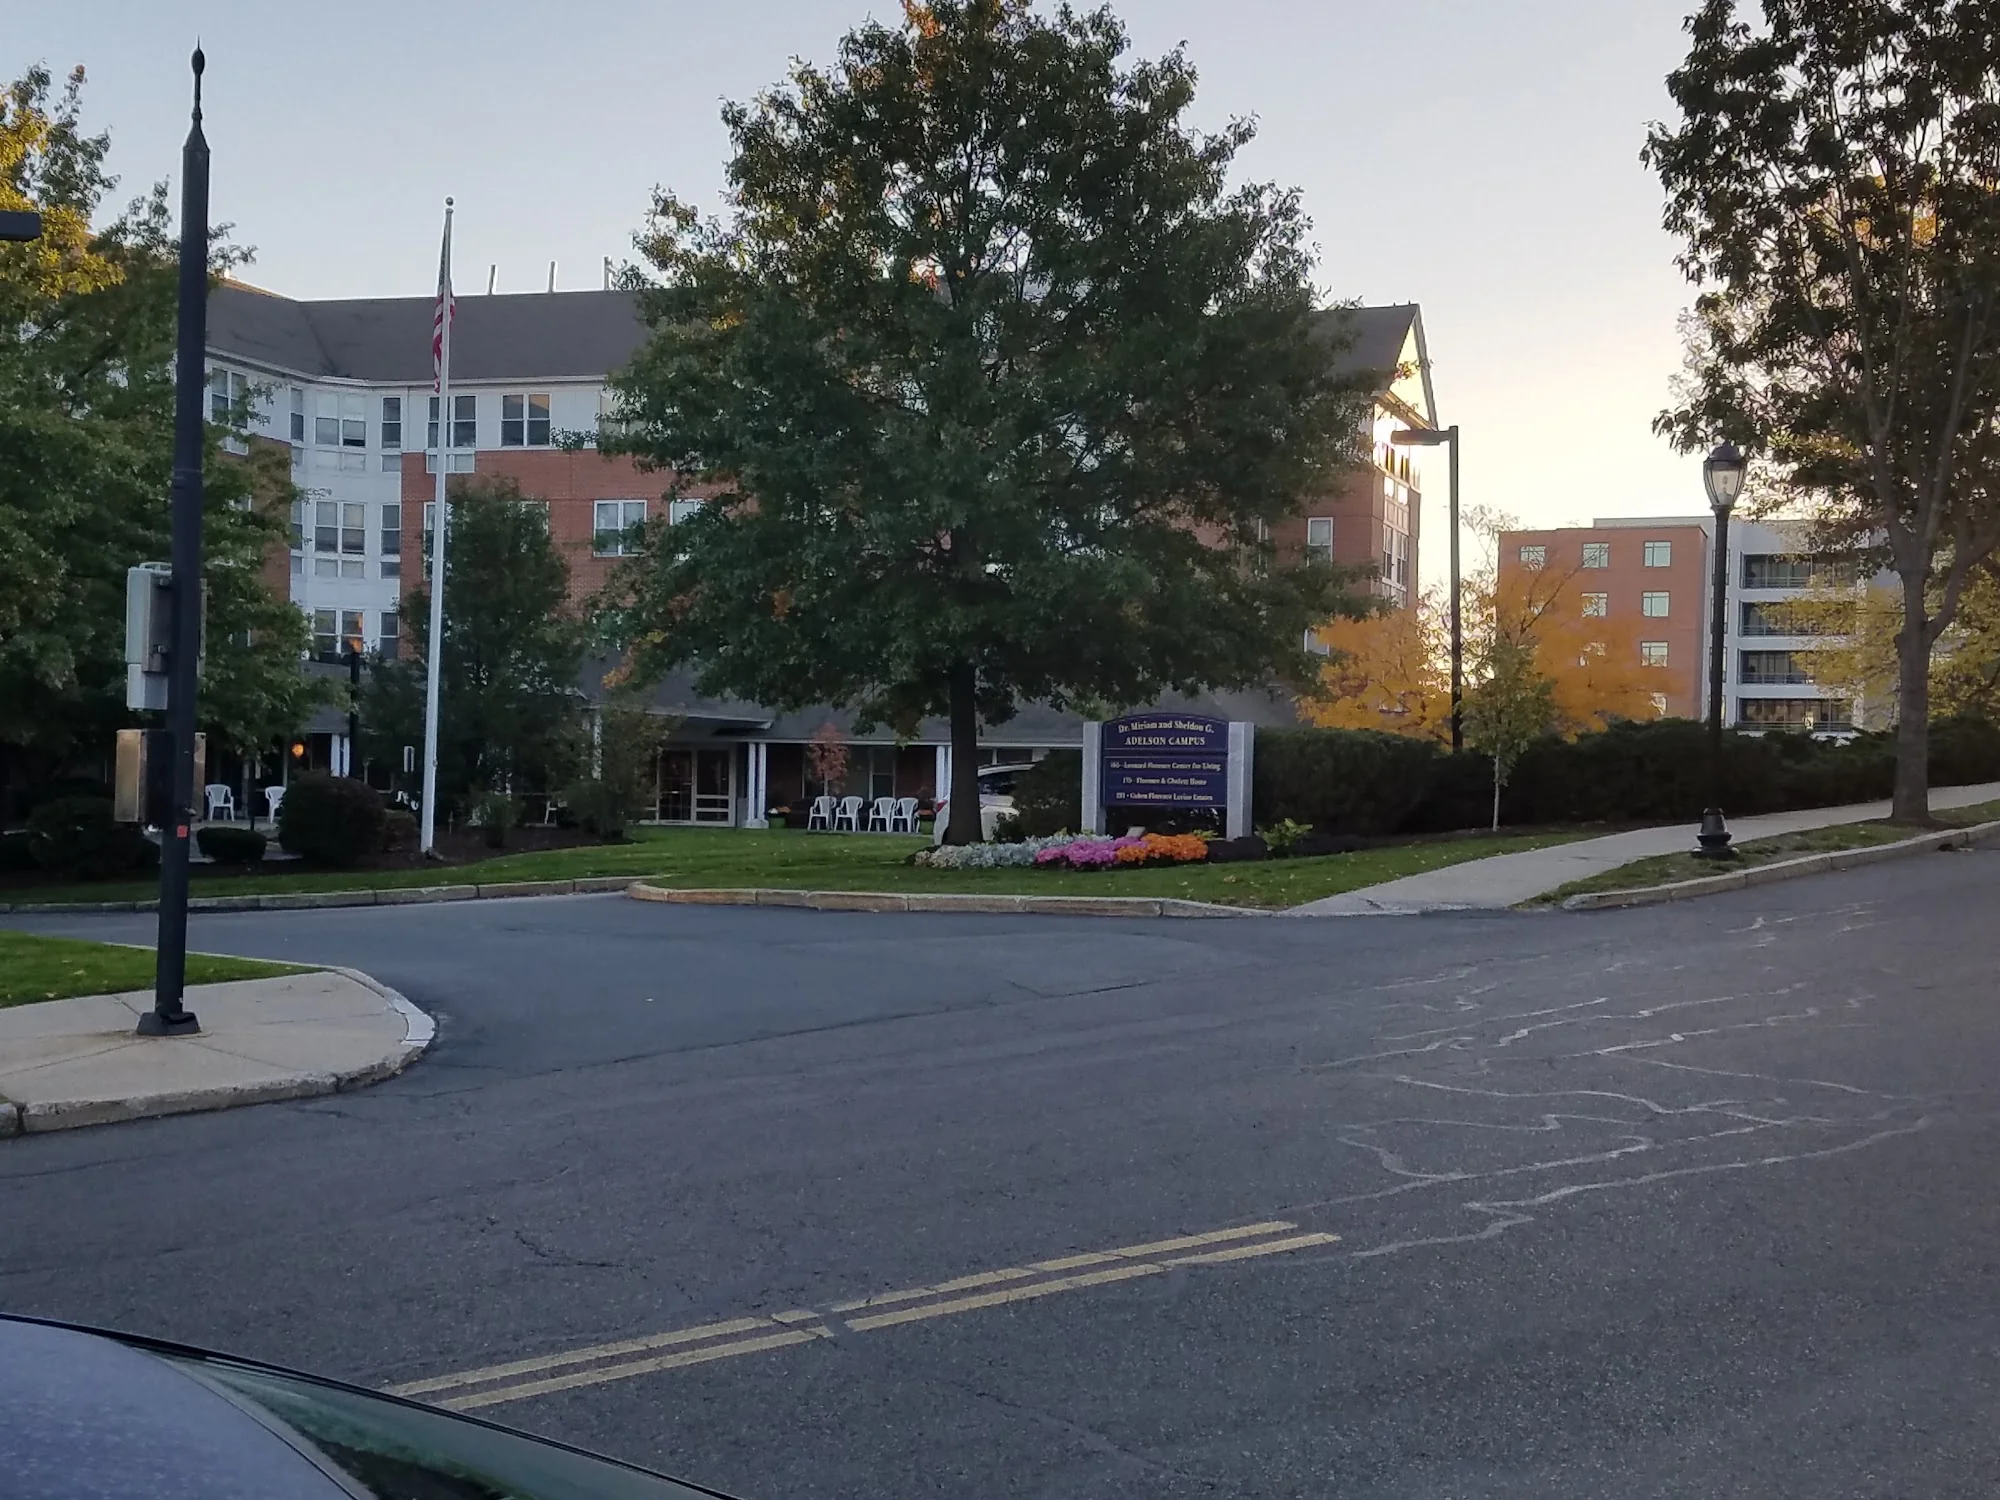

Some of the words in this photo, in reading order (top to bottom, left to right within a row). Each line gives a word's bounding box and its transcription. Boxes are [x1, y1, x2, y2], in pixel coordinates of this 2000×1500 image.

[1131, 721, 1157, 731] Miriam
[1158, 720, 1172, 729] and
[1174, 720, 1204, 732] Sheldon
[1125, 736, 1166, 746] ADELSON
[1168, 736, 1205, 746] CAMPUS
